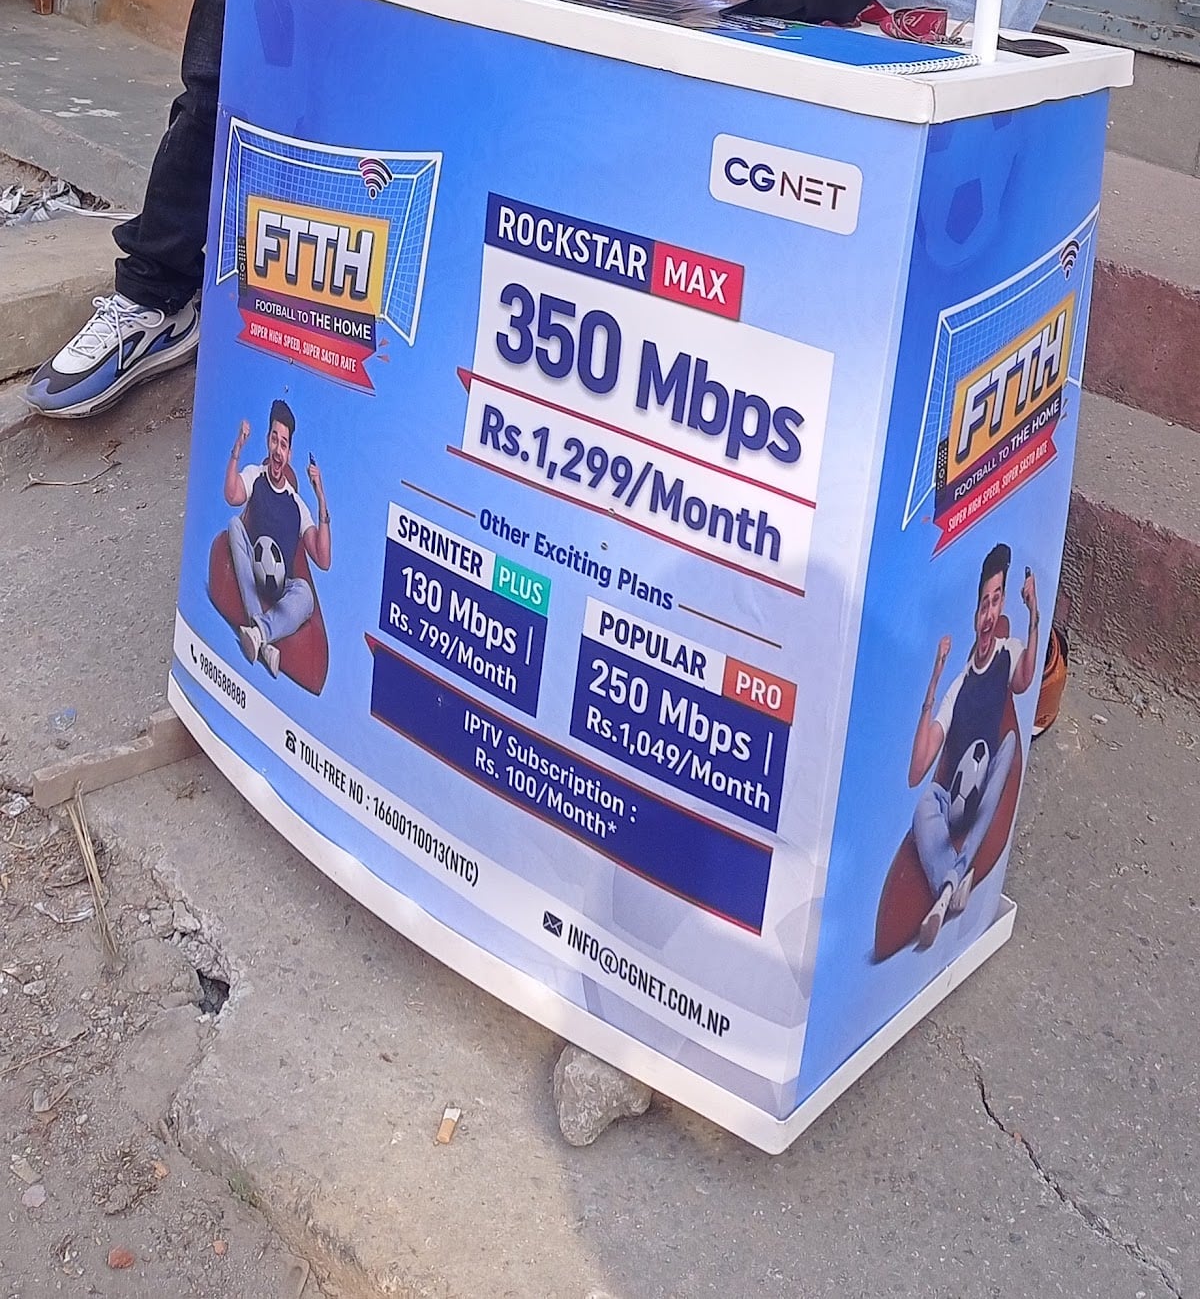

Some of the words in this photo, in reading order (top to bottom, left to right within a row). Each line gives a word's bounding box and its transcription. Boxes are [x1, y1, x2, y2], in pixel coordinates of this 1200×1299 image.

[724, 157, 776, 192] CG
[779, 170, 846, 211] NET
[254, 210, 374, 299] FTTH
[498, 206, 648, 282] ROCKSTAR
[663, 256, 728, 304] MAX
[250, 322, 268, 341] SUPER
[268, 329, 282, 345] HIGH
[283, 333, 302, 355] SPEED,
[302, 342, 321, 360] SUPER
[321, 348, 340, 367] SASTO
[340, 355, 357, 373] RATE
[255, 298, 296, 321] FOOTBALL
[297, 310, 309, 324] TO
[309, 310, 331, 331] THE
[333, 316, 372, 340] HOME
[496, 282, 622, 395] 350
[635, 339, 805, 464] Mbps
[956, 310, 1067, 461] FTTH
[480, 404, 782, 563] Rs.1,299/Month
[948, 506, 967, 533] SUPER
[967, 495, 982, 518] HIGH
[1001, 465, 1019, 489] SUPER
[1018, 451, 1036, 476] SASTO
[1036, 440, 1048, 462] RATE
[954, 459, 997, 501] FOOTBALL
[998, 445, 1010, 464] TO
[1010, 427, 1030, 453] THE
[1031, 399, 1060, 436] HOME
[397, 514, 484, 578] SPRINTER
[498, 566, 544, 606] PLUS
[479, 508, 530, 548] Other
[533, 534, 612, 587] Exciting
[617, 567, 673, 610] Plans
[389, 602, 413, 636] Rs.
[419, 618, 518, 695] 799/Month
[401, 567, 443, 613] 130
[449, 590, 518, 655] Mbps
[199, 653, 247, 710] 9880588888
[599, 611, 707, 680] POPULAR
[735, 671, 782, 710] PRO
[463, 709, 503, 747] IPTV
[506, 734, 625, 808] Subscription
[586, 705, 771, 813] Rs.1,049/Month
[588, 659, 649, 715] 250
[658, 689, 752, 762] Mbps
[474, 746, 500, 779] Rs.
[299, 740, 346, 793] TOLL-FREE
[348, 779, 364, 805] NO
[373, 797, 479, 887] 16600110013(NTC)
[567, 924, 731, 1038] INFO@CGNET.COM.NP
